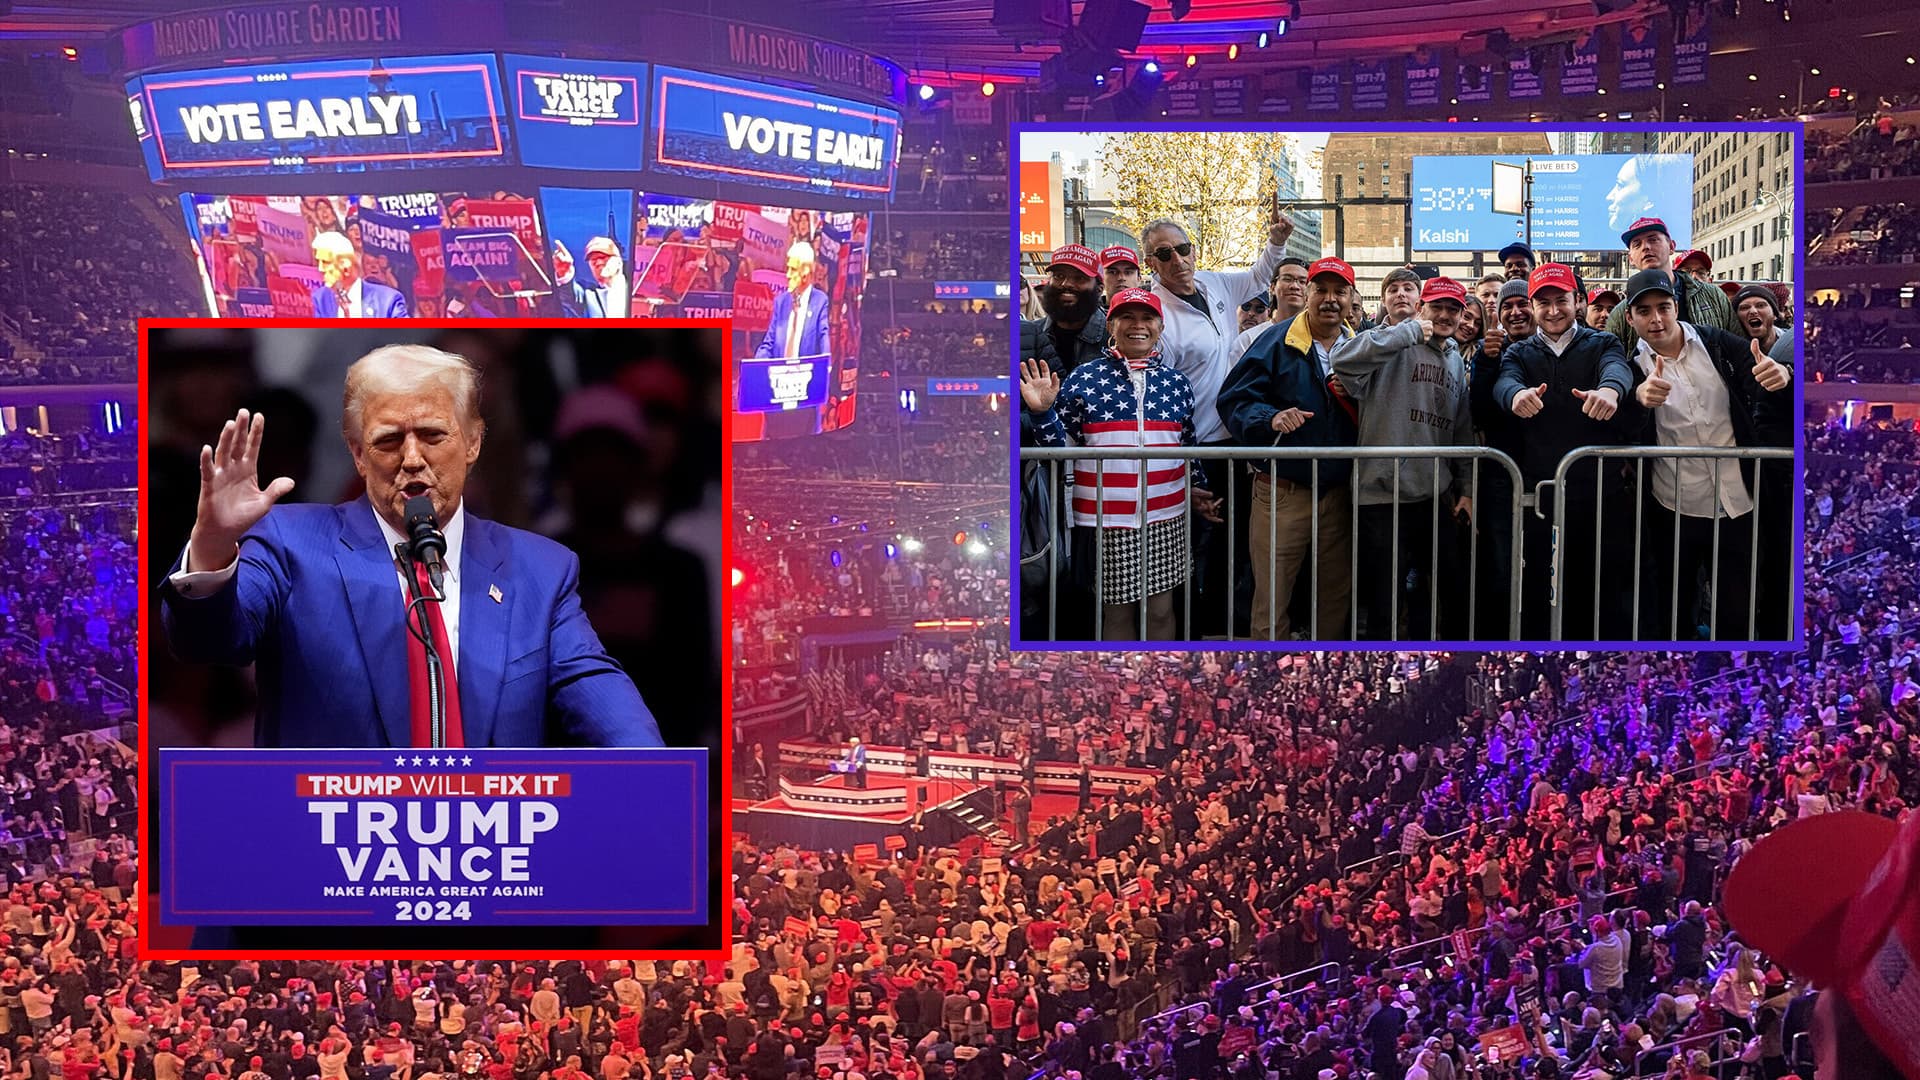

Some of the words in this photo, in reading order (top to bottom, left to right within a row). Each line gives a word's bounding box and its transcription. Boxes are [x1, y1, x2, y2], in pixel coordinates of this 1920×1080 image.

[153, 16, 221, 56] MADISON
[226, 10, 302, 49] SQUARE
[307, 4, 400, 43] GARDEN
[729, 25, 809, 73] MADISON
[813, 41, 862, 85] SQUARE
[534, 77, 622, 98] TRUMP
[545, 94, 615, 113] VANCE
[180, 102, 264, 144] VOTE
[267, 95, 422, 140] EARLY!
[723, 111, 812, 161] VOTE
[816, 129, 884, 171] EARLY!
[378, 193, 437, 211] TRUMP
[409, 207, 427, 218] FIX
[428, 206, 439, 216] IT
[261, 219, 304, 240] TRUMP
[359, 219, 410, 242] TRUMP
[472, 214, 532, 228] TRUMP
[446, 240, 487, 252] DREAM
[489, 240, 513, 252] BIG,
[748, 227, 784, 248] TRUMP
[1419, 228, 1470, 244] Kalshi
[450, 252, 510, 267] AGAIN!
[1054, 253, 1073, 261] GREAT
[1074, 254, 1094, 265] AGAIN
[1070, 246, 1097, 260] AMERICA
[1411, 363, 1445, 386] ARIZONA
[308, 775, 402, 795] TRUMP
[409, 775, 475, 795] WILL
[483, 775, 528, 795] FIX
[534, 775, 559, 795] IT
[308, 801, 560, 845] TRUMP
[336, 846, 530, 882] VANCE
[323, 886, 365, 897] MAKE
[369, 886, 436, 897] AMERICA
[440, 886, 488, 897] GREAT
[492, 886, 544, 897] AGAIN!
[395, 901, 472, 921] 2024
